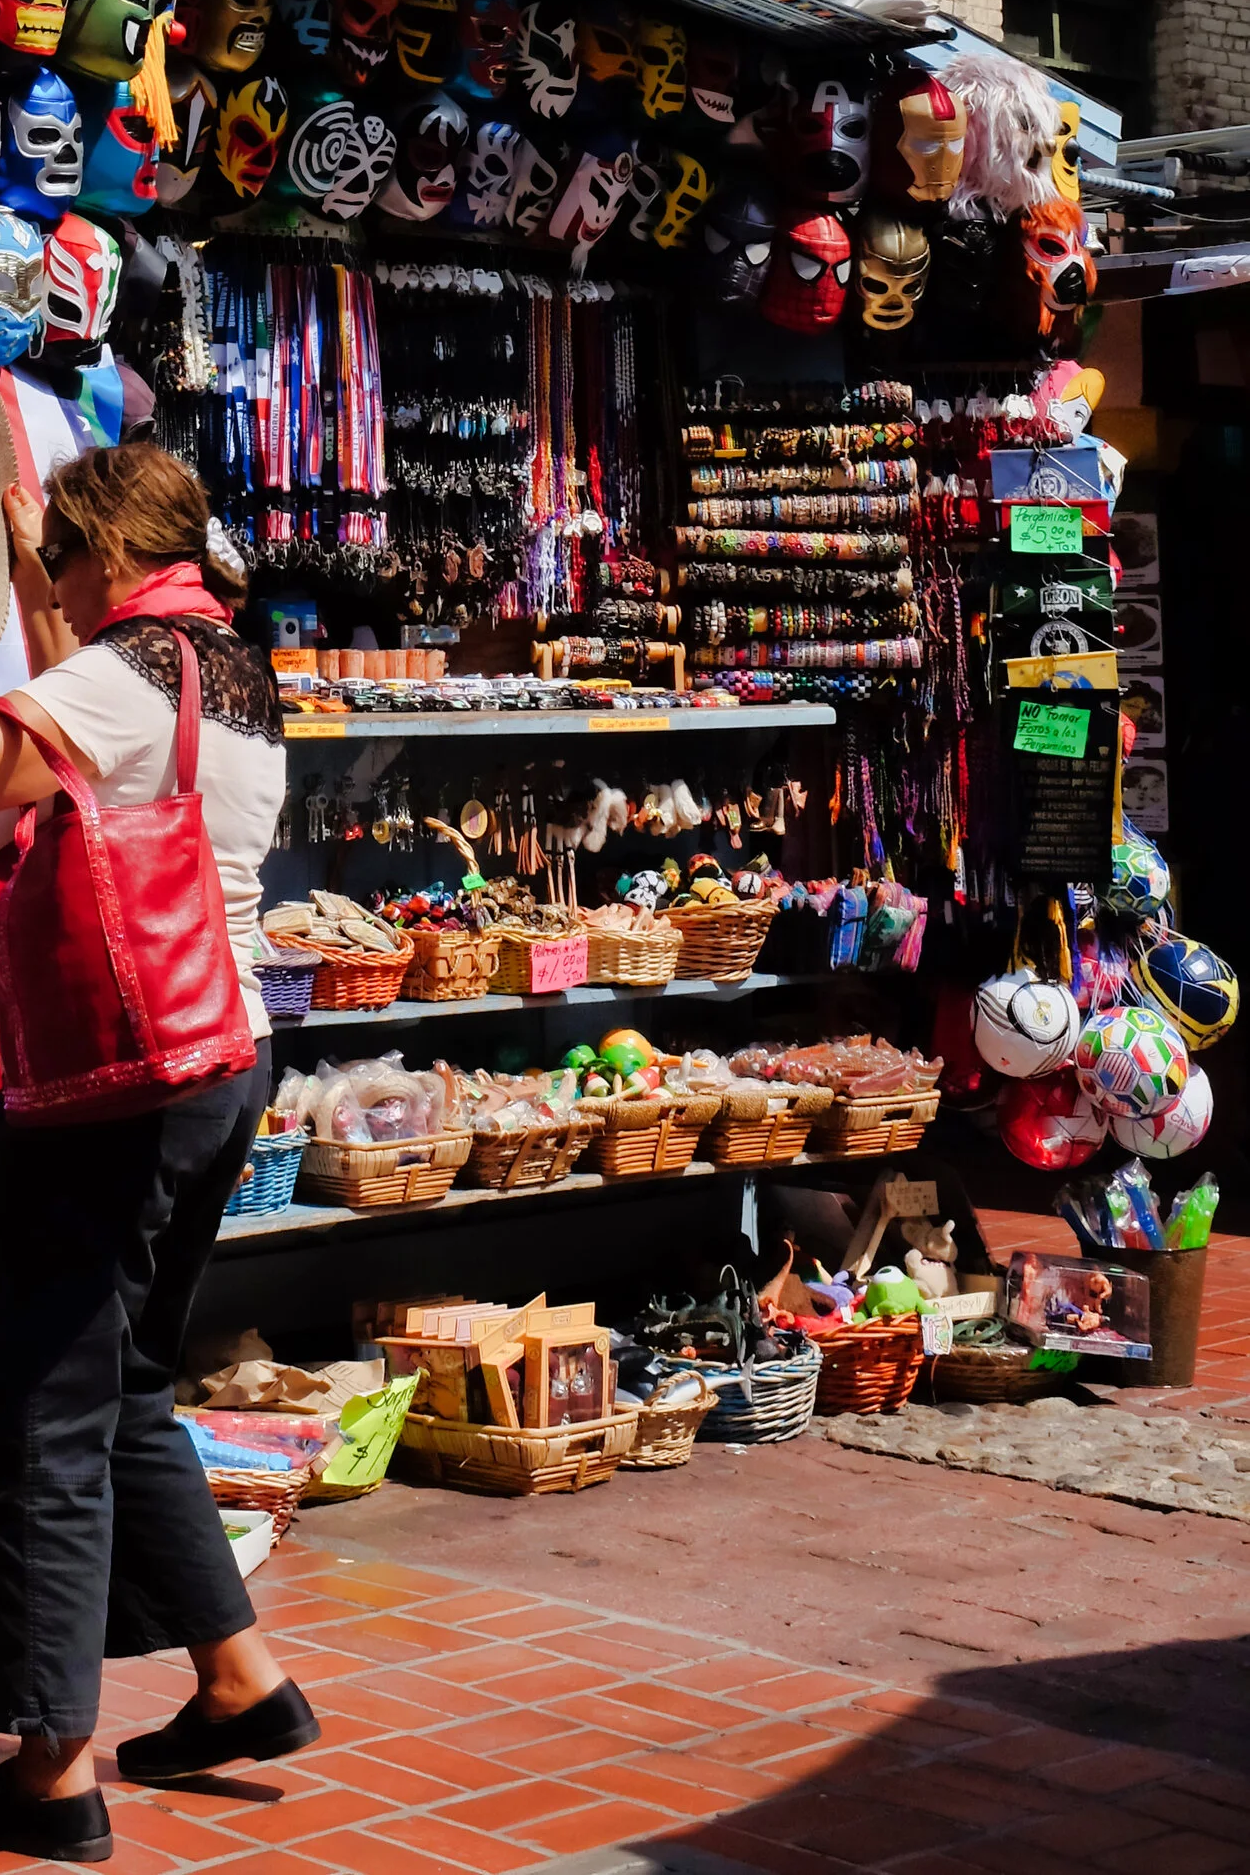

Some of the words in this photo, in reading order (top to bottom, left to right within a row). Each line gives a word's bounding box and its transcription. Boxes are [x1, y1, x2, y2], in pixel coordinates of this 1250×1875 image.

[271, 403, 280, 458] CALIFORNIA
[325, 417, 334, 461] MEXICO
[1015, 507, 1075, 529] Pergaminos
[1021, 704, 1041, 720] NO
[1062, 726, 1077, 738] los
[1021, 737, 1077, 754] Pergaminos
